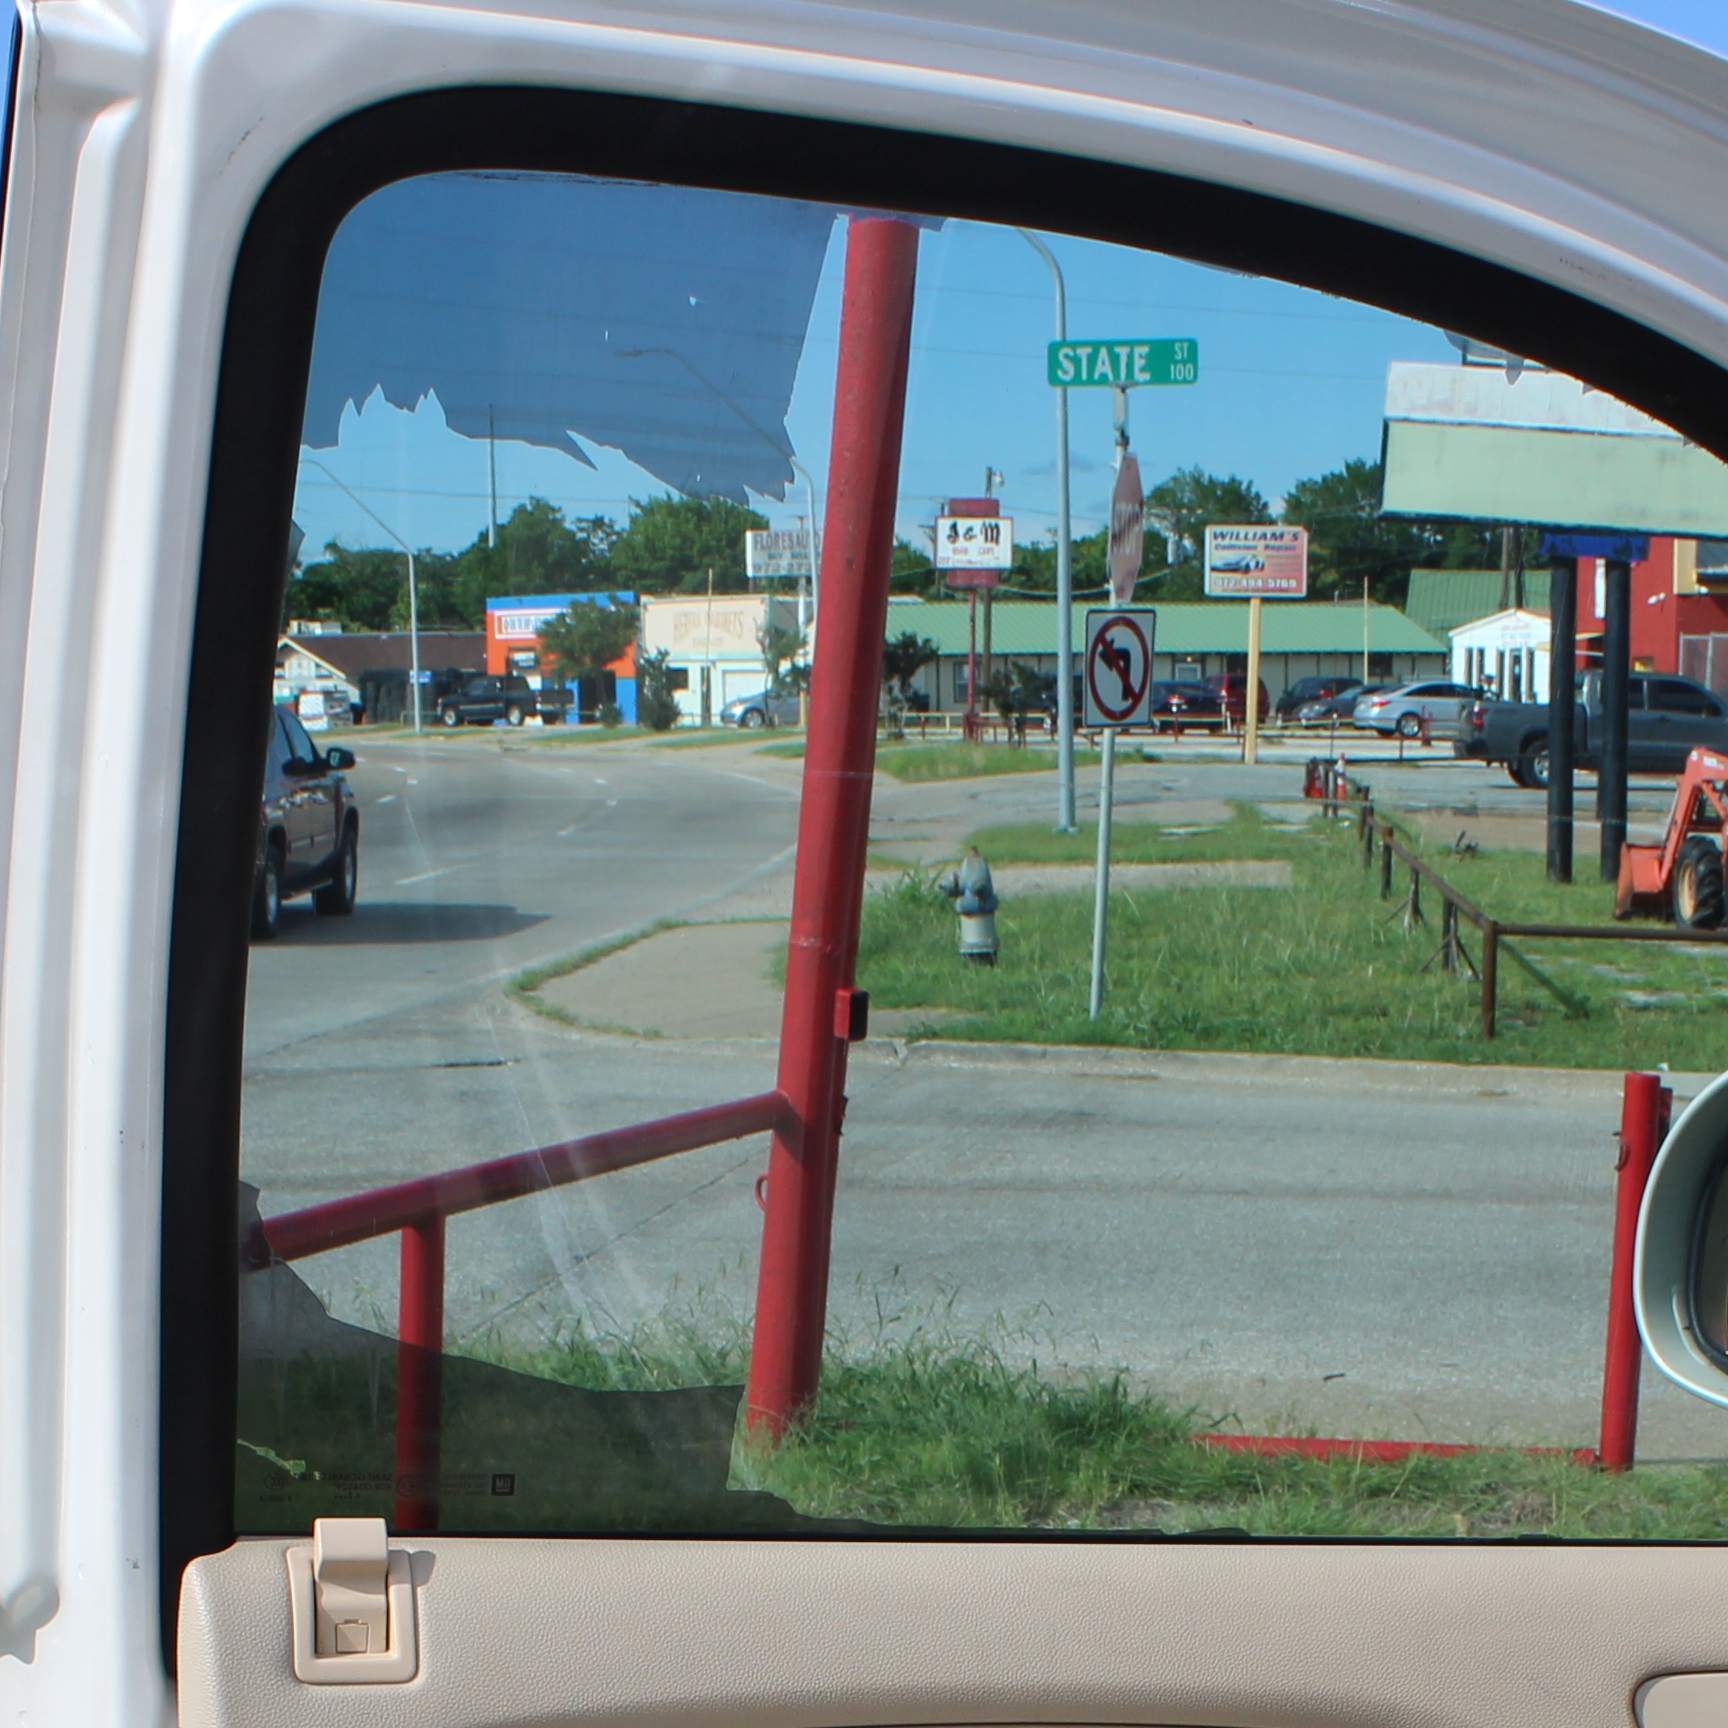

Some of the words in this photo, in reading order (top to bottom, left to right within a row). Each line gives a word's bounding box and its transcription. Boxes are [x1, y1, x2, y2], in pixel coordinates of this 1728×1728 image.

[1057, 345, 1152, 382] STATE
[1174, 341, 1189, 360] ST
[1170, 362, 1195, 380] 100
[754, 531, 794, 551] FLORES
[980, 519, 1001, 547] M
[1213, 530, 1300, 541] WILLIAM'S
